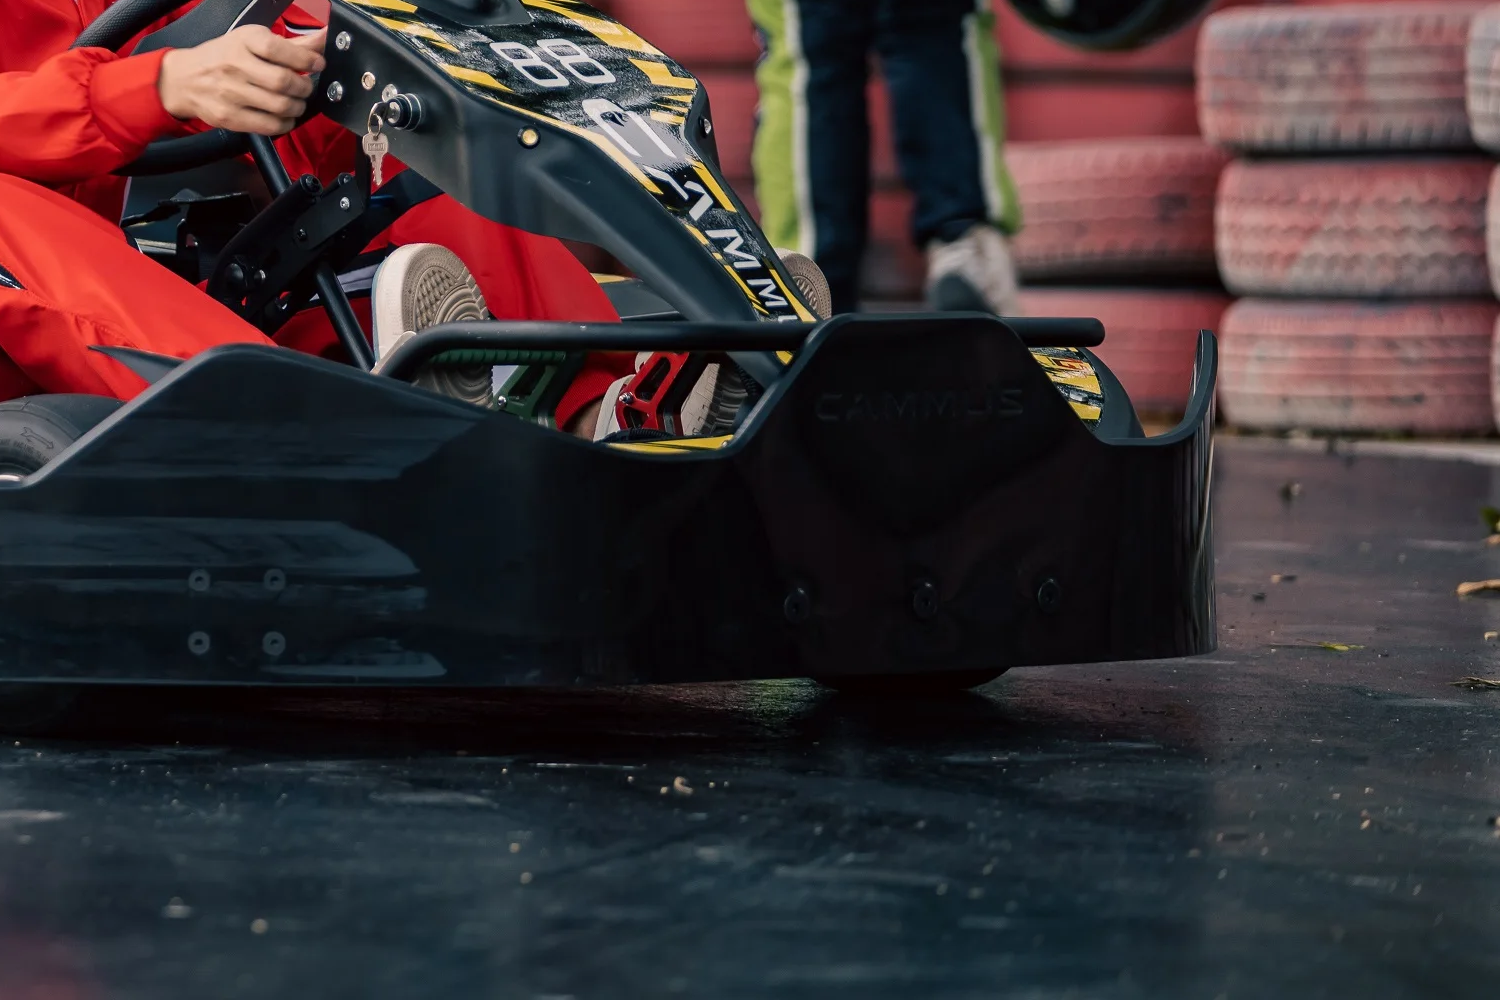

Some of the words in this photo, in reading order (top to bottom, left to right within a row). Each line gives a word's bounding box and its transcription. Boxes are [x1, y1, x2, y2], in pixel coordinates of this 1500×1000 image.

[489, 38, 616, 88] 88
[582, 97, 798, 322] CAMM
[815, 388, 1025, 422] CAMMUS
